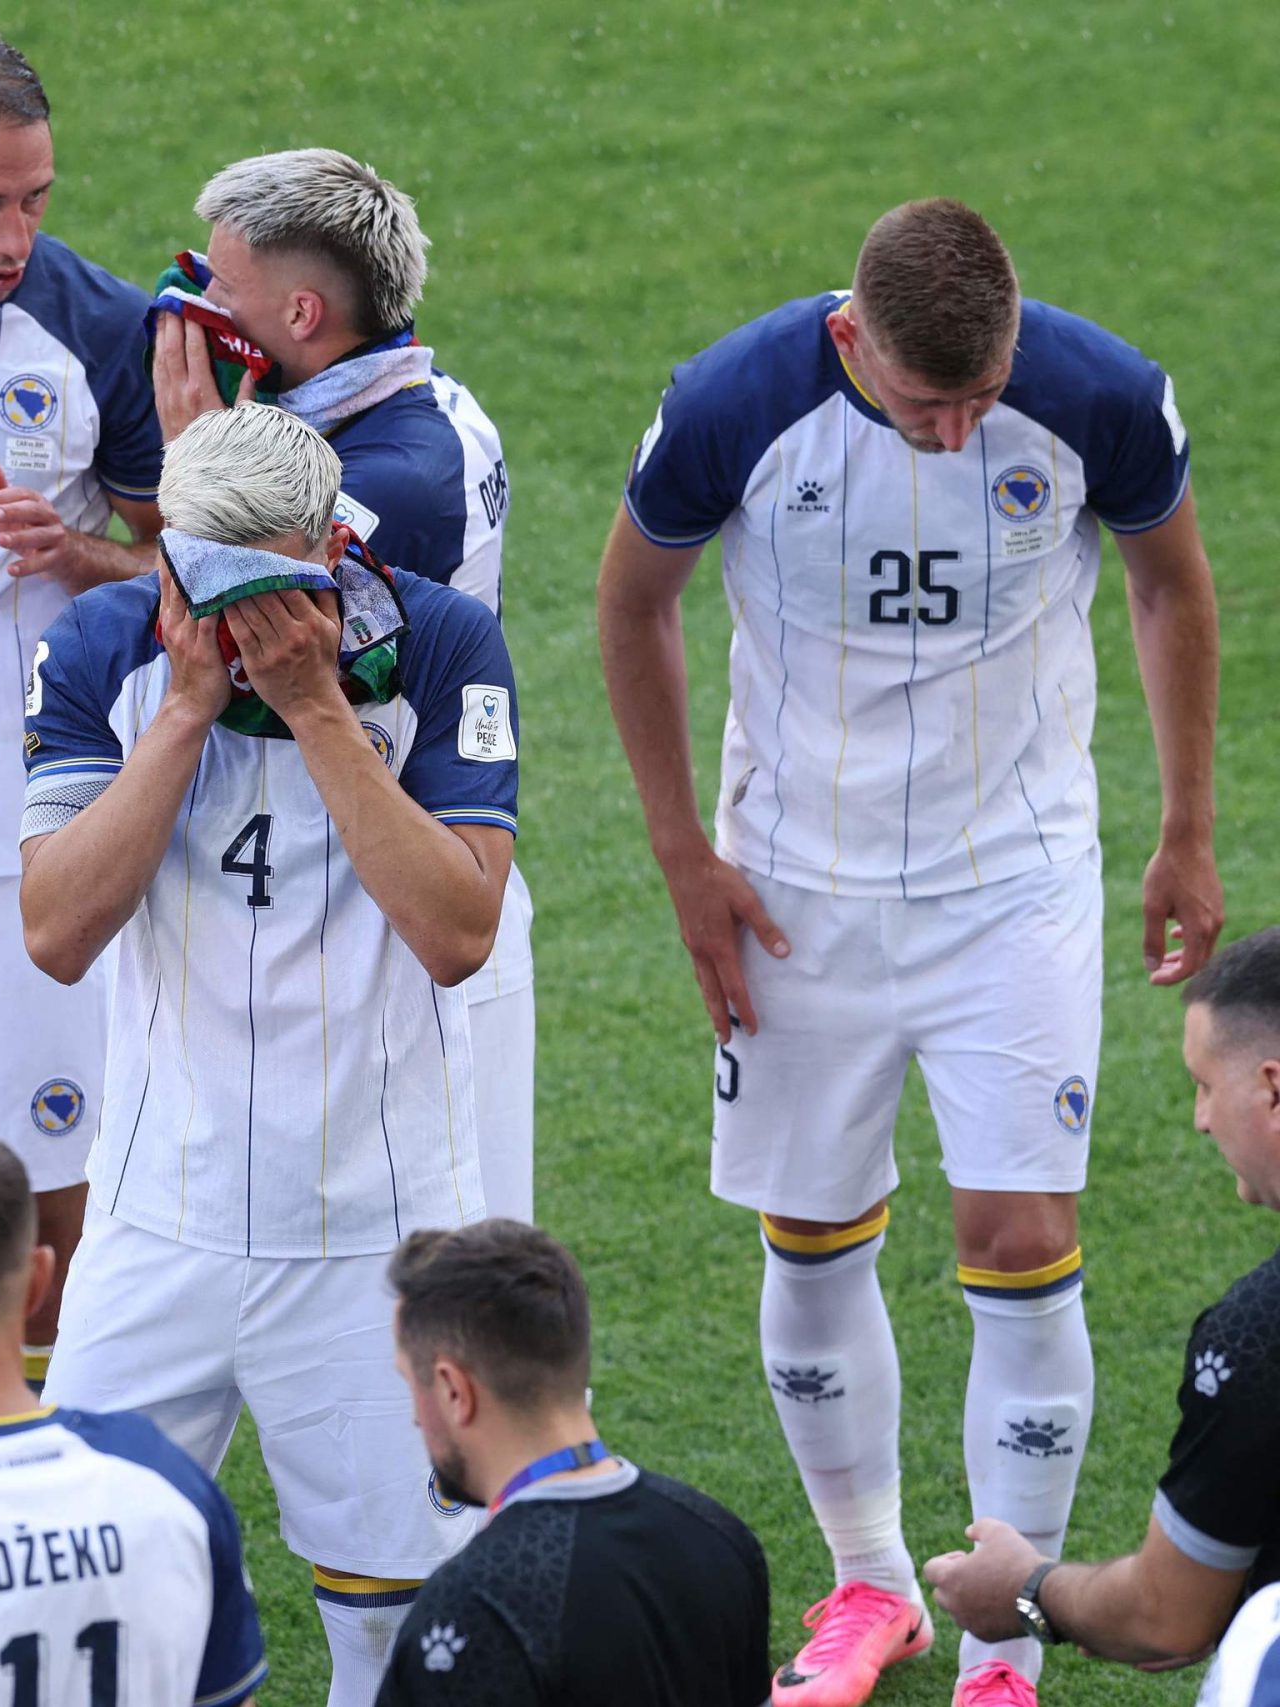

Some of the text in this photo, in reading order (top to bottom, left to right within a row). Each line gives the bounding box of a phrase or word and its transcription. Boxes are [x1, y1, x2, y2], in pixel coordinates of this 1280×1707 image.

[787, 504, 830, 513] KELME
[869, 550, 962, 626] 25
[221, 813, 274, 910] 4
